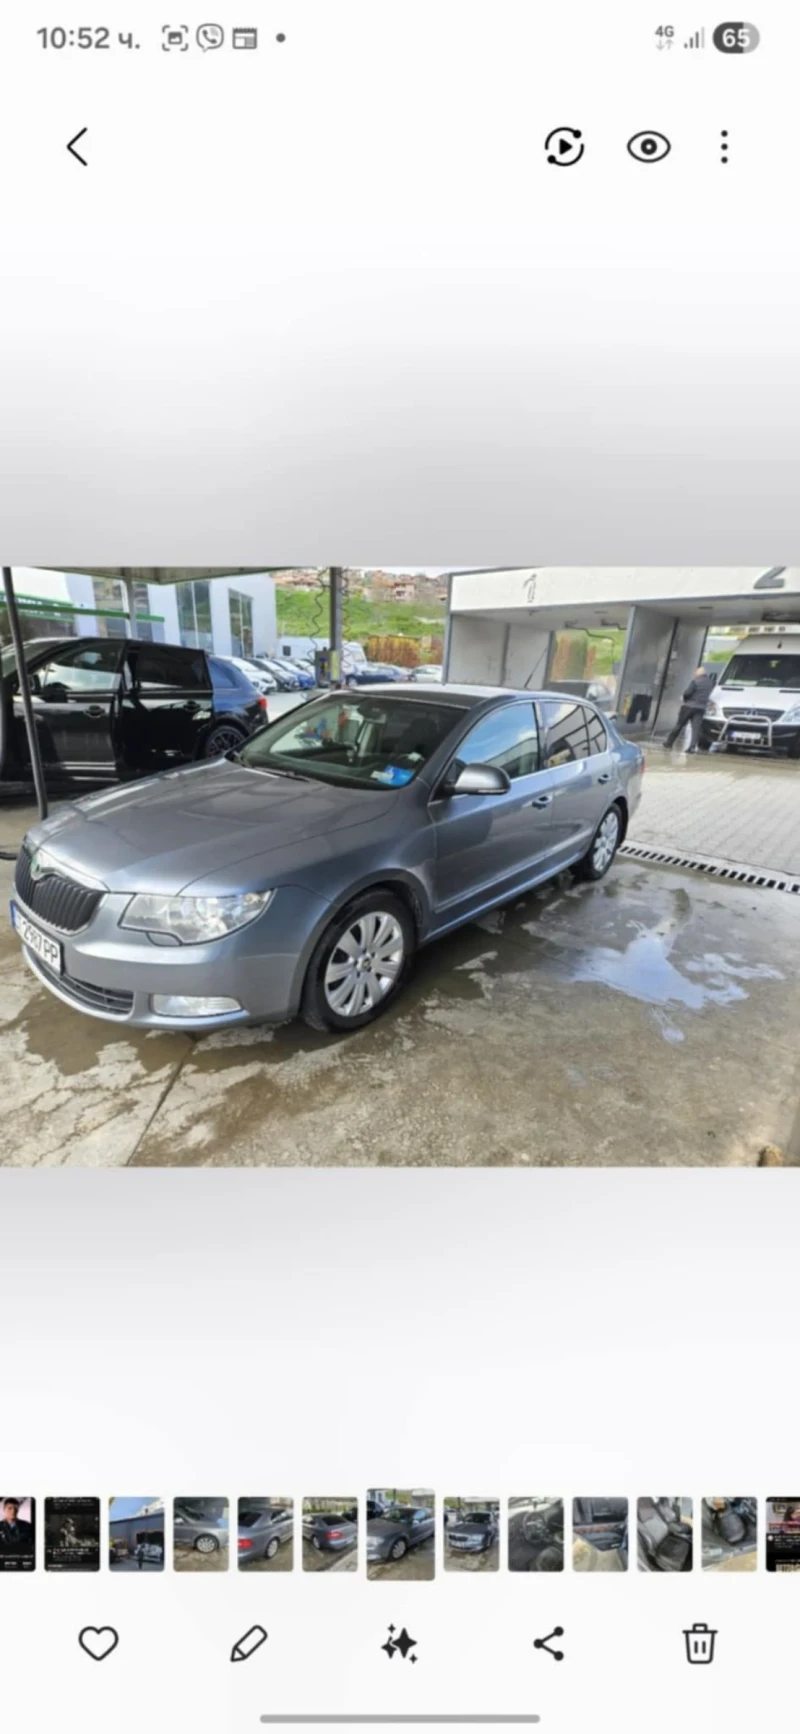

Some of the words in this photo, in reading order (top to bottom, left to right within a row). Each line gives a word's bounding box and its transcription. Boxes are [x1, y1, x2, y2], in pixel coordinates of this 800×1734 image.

[36, 26, 110, 49] 10:52
[118, 32, 141, 49] ч.
[655, 25, 675, 38] 4G
[722, 28, 751, 48] 65
